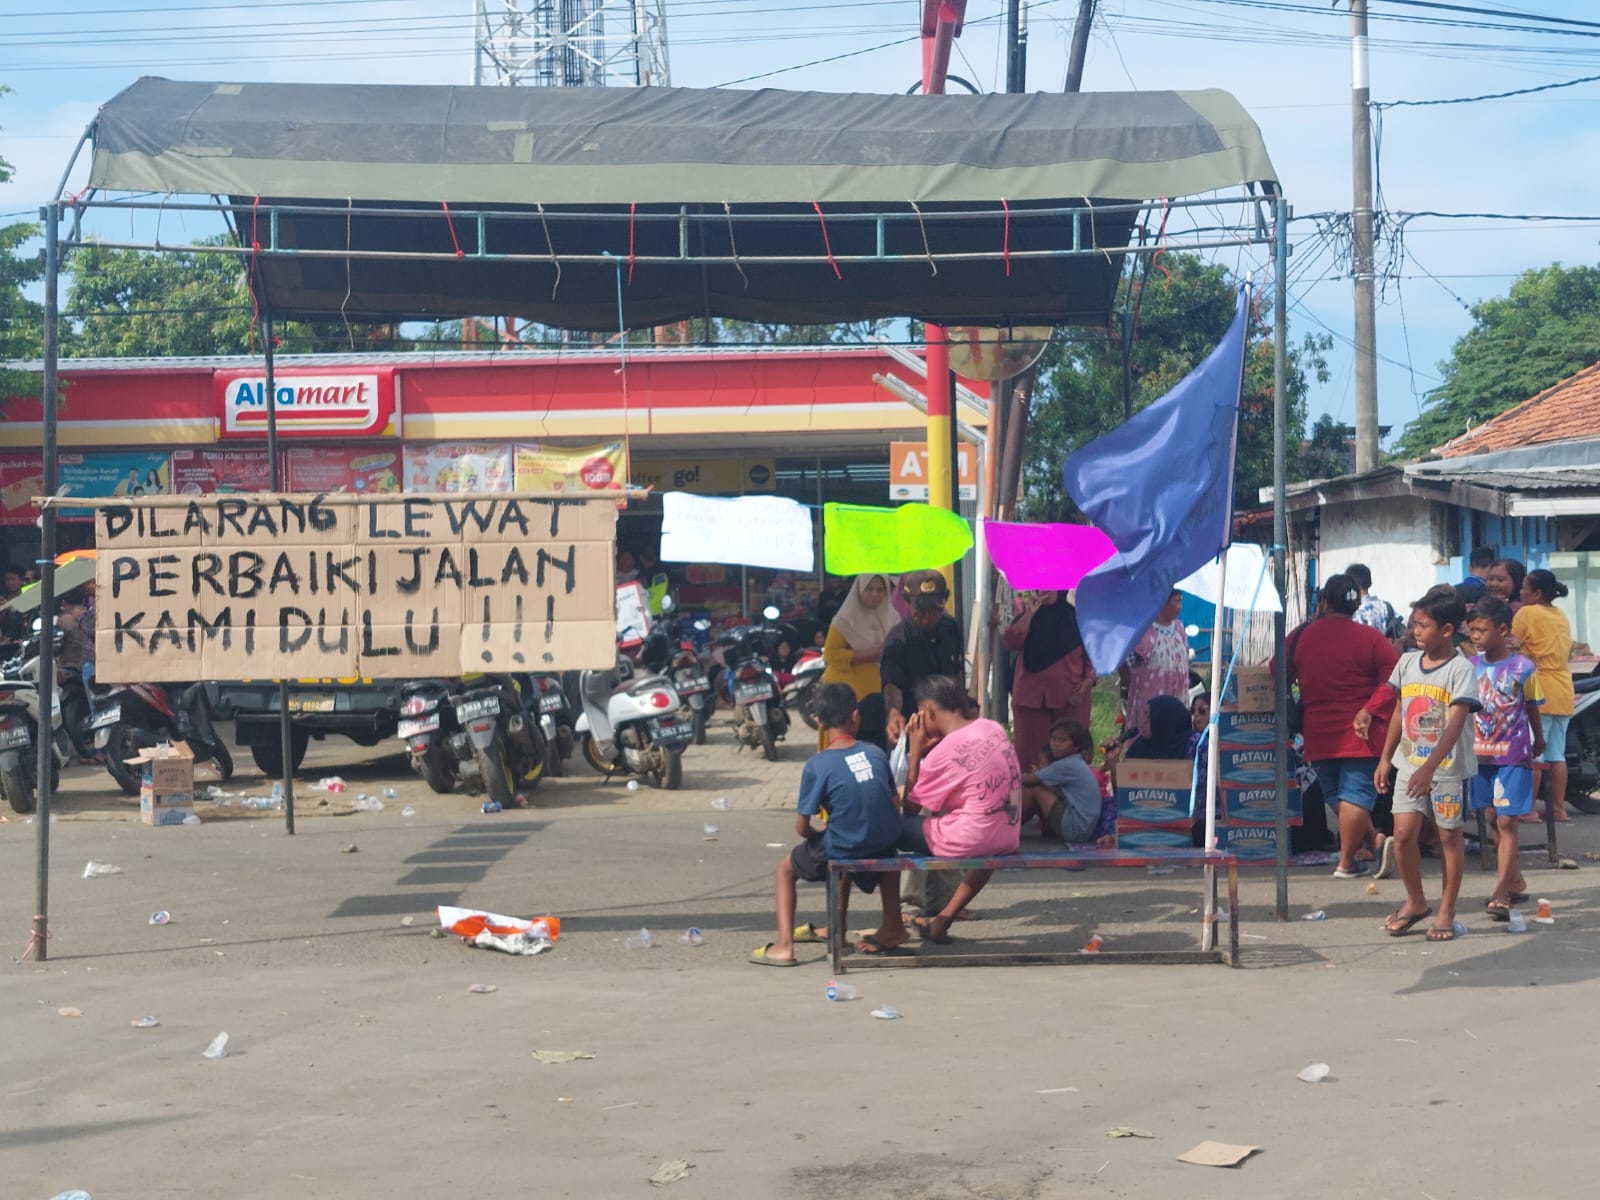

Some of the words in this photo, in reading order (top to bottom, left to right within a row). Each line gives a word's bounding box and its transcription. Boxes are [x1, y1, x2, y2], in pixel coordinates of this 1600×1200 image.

[674, 464, 699, 488] go!
[101, 495, 337, 539] DILARANG
[369, 498, 587, 538] LEWAT
[112, 550, 377, 599] PERBAIKI
[396, 545, 576, 594] JALAN
[114, 607, 255, 655] KAMI
[279, 606, 440, 658] DULU
[1128, 788, 1177, 803] BATAVIA
[1239, 789, 1276, 802] BATAV
